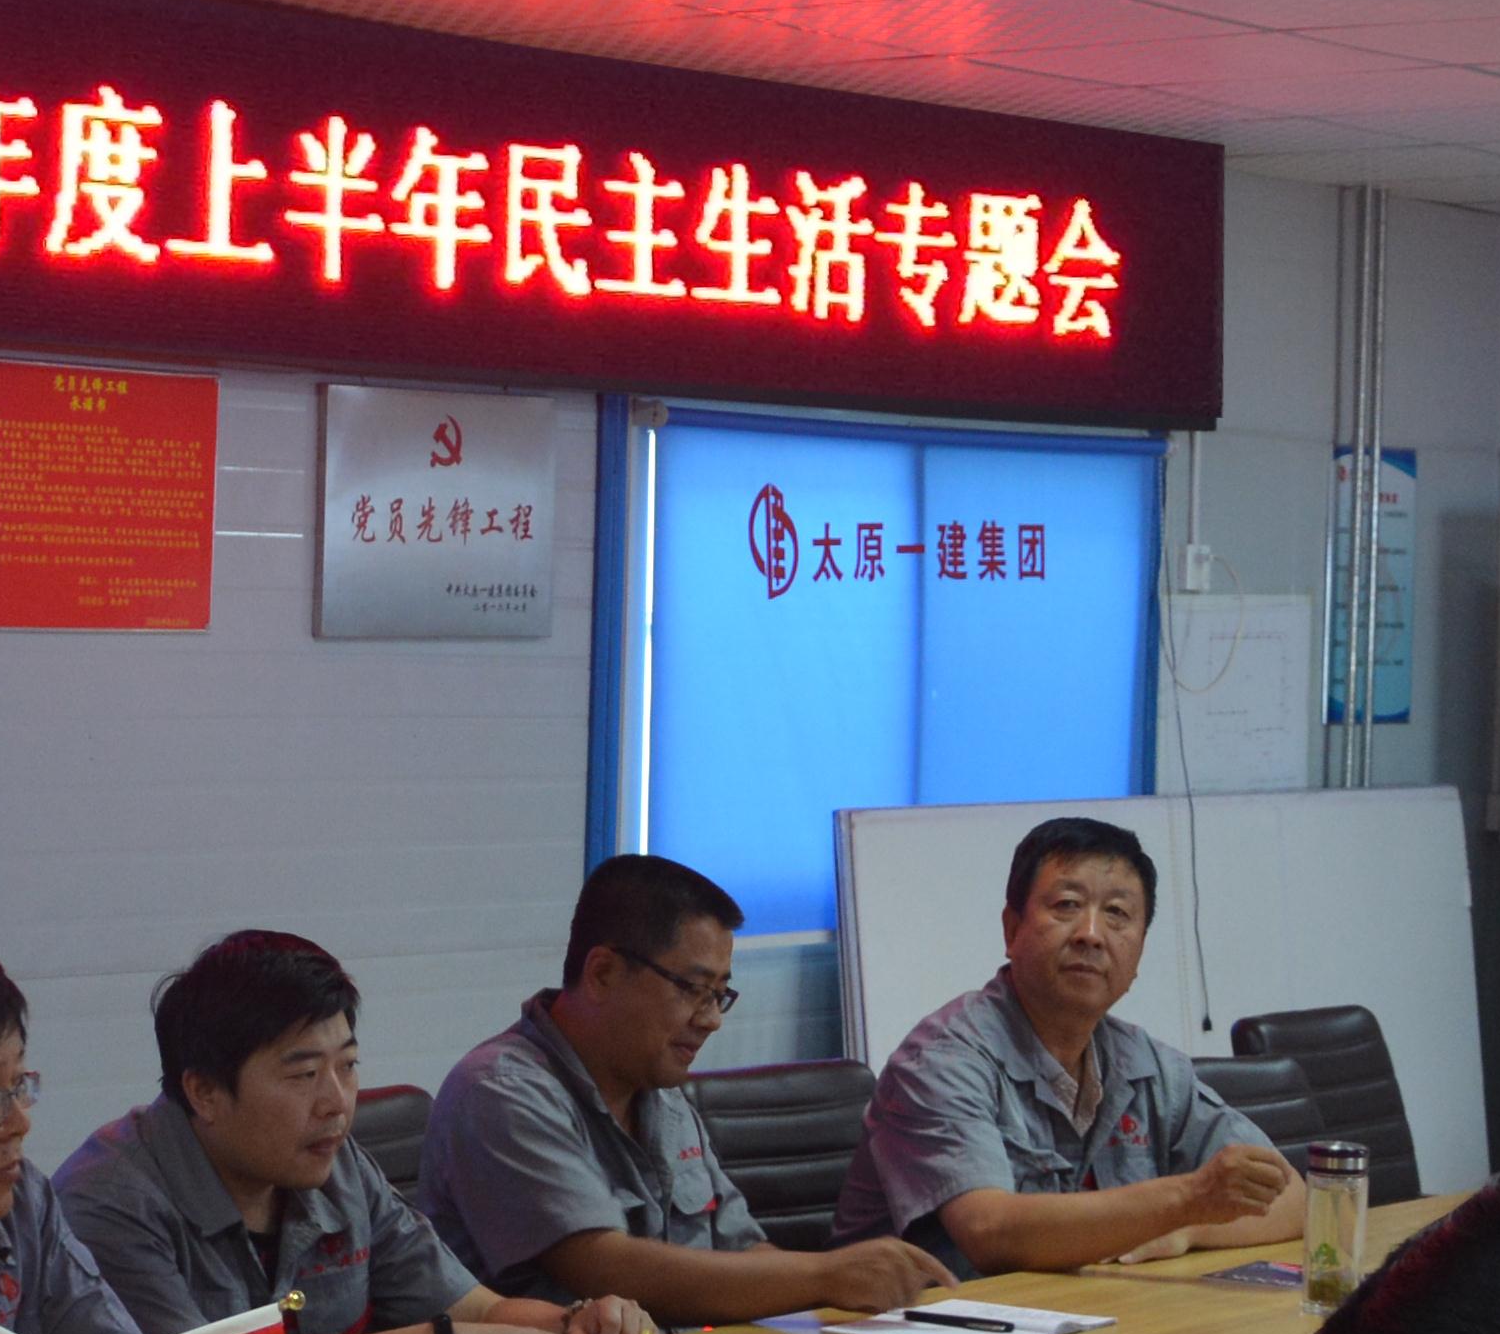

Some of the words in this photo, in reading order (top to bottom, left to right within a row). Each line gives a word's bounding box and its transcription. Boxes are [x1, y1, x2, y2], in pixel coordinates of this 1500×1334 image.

[351, 494, 535, 546] 党员先锋工程
[811, 519, 1046, 582] 太原一建集团
